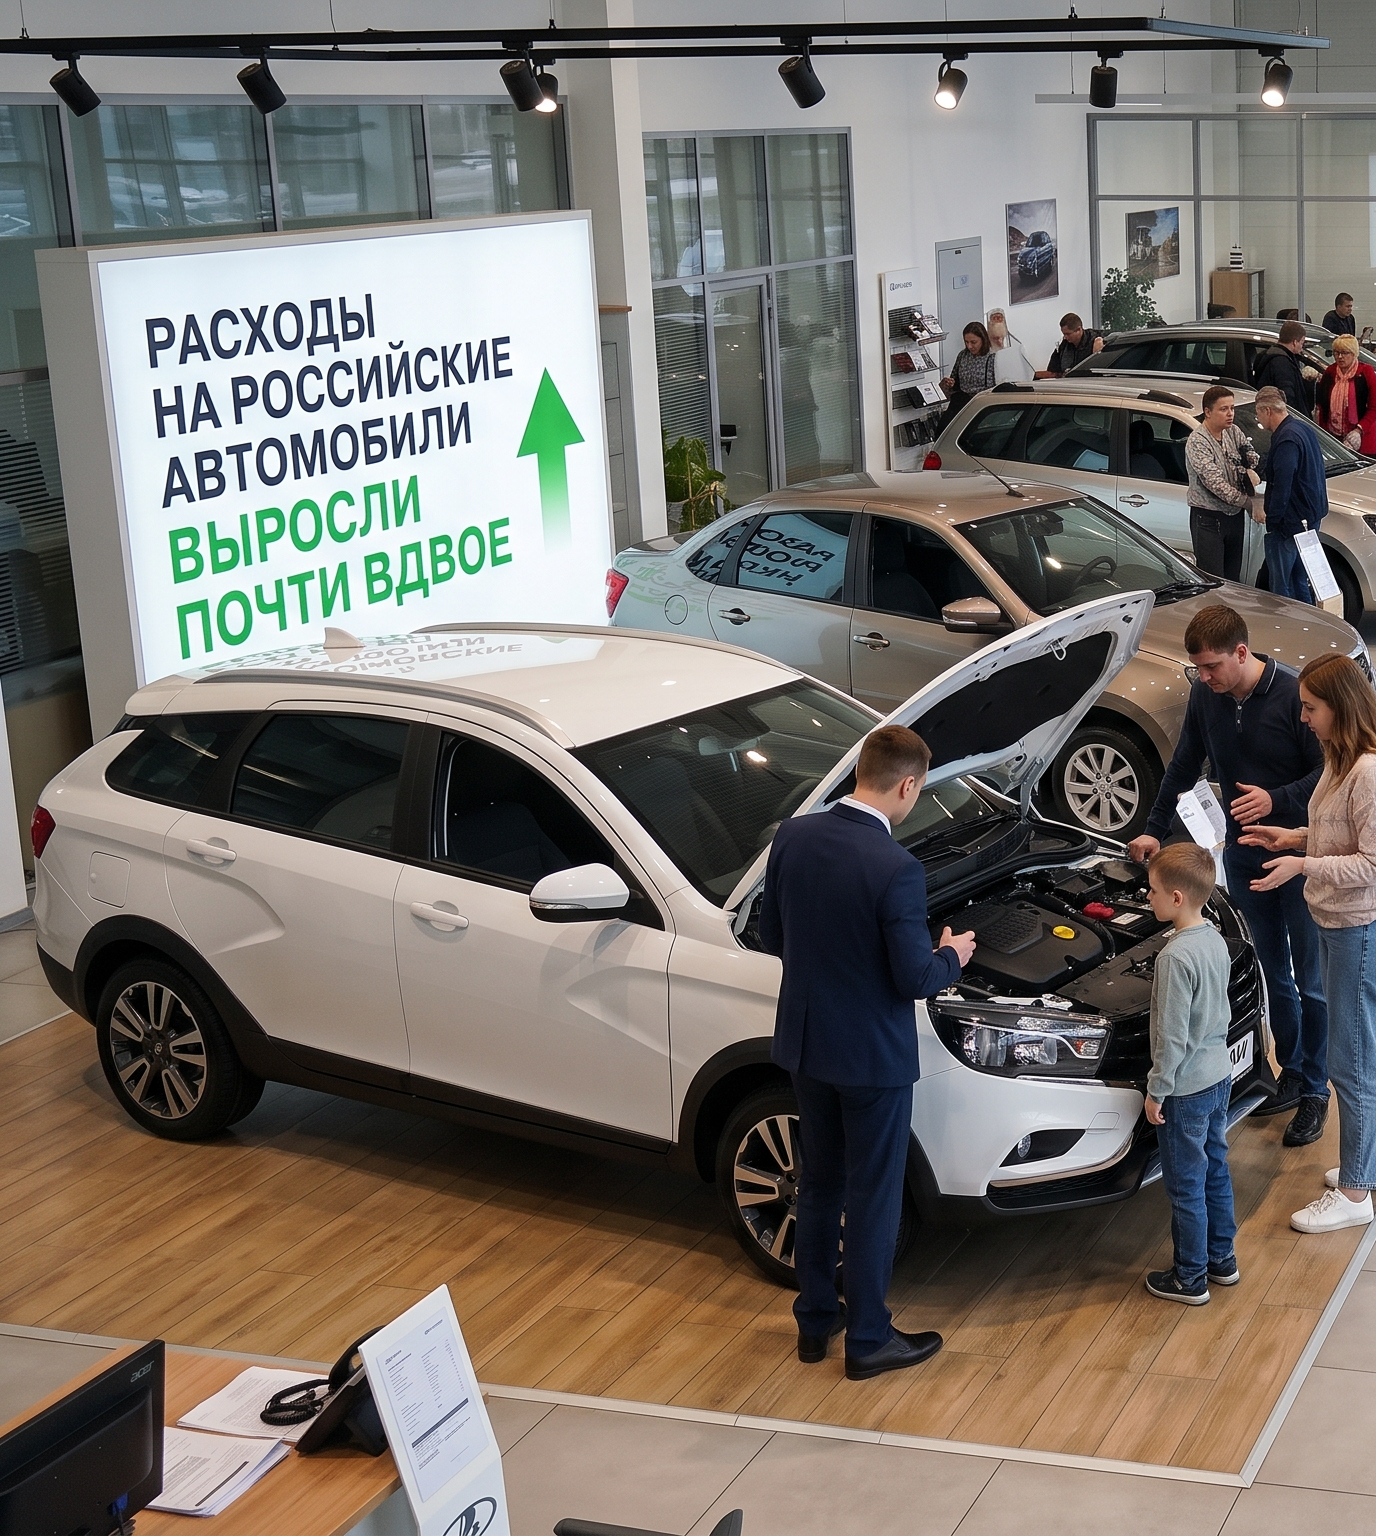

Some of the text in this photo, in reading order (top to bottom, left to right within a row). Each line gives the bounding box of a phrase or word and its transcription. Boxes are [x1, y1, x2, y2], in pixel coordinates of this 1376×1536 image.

[145, 293, 375, 369] РАСХОДЫ
[152, 336, 513, 439] НА РОССИЙСКИЕ
[162, 401, 472, 509] АВТОМОБИЛИ
[168, 474, 422, 585] ВЫРОСЛИ
[176, 561, 352, 660] ПОЧТИ
[363, 517, 513, 607] ВДВОЕ
